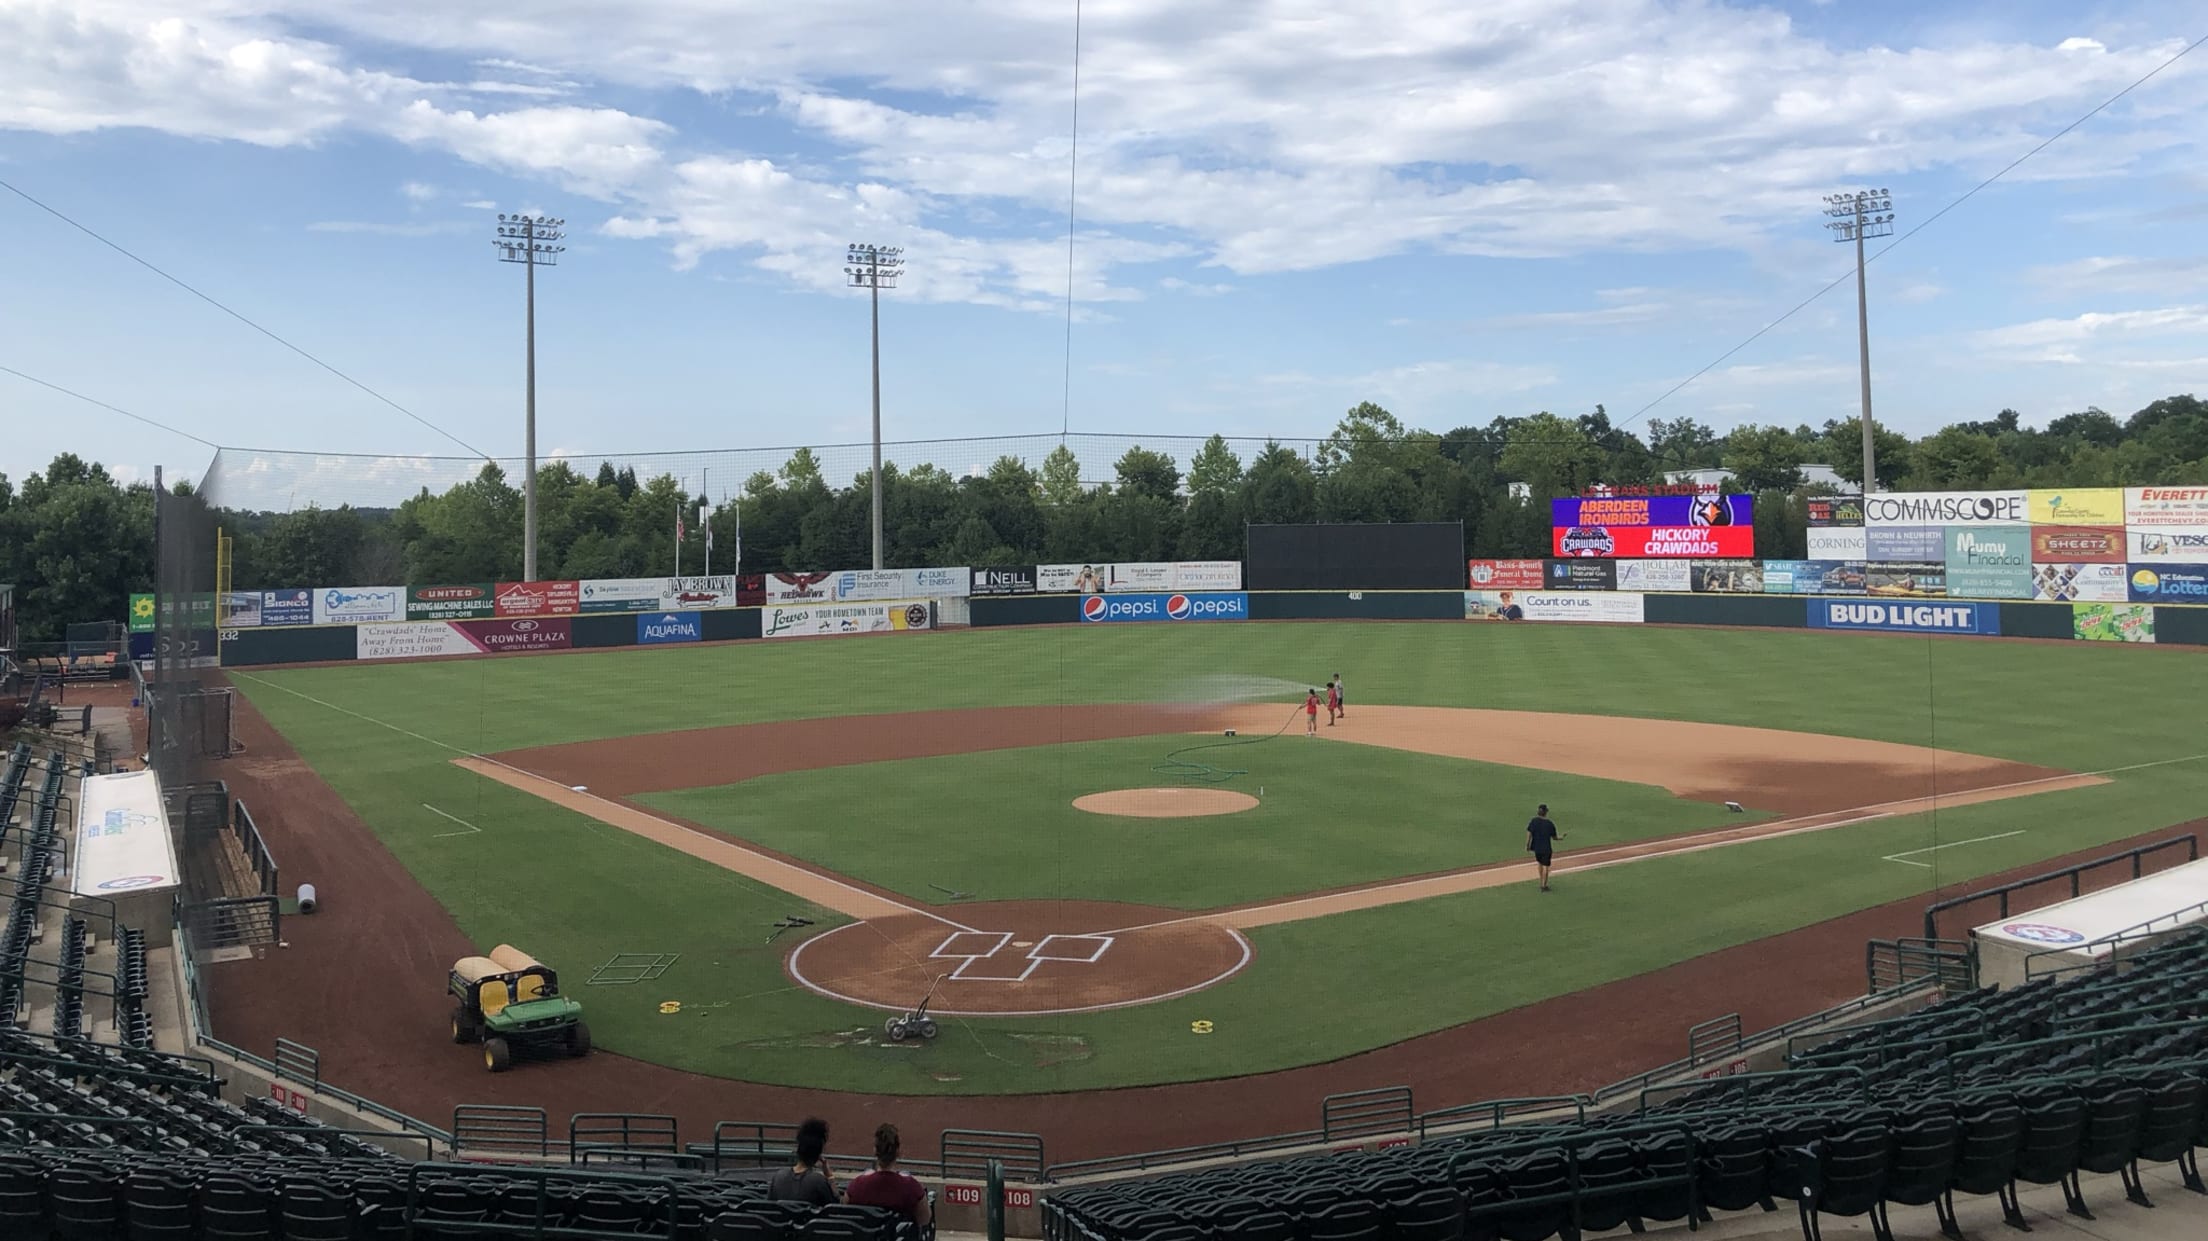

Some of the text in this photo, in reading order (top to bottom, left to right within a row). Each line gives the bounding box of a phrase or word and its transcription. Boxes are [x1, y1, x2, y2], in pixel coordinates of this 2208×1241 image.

[1579, 500, 1649, 512] ABERDEEN
[1866, 496, 2022, 521] COMMSCOPE
[1579, 512, 1649, 525] IRONBIRDS
[1652, 528, 1710, 541] HICKORY
[1562, 538, 1613, 552] CRAWDADS
[1644, 541, 1719, 554] CRAWDADS
[1808, 537, 1865, 549] CORNING
[1956, 532, 2006, 556] Mumy
[2048, 540, 2107, 549] SHEETZ
[1968, 545, 2024, 566] Financial
[857, 571, 901, 581] First Security
[928, 570, 946, 578] DUKE
[990, 571, 1030, 584] NEILL
[663, 578, 689, 598] JAY
[690, 576, 732, 596] BROWN
[857, 580, 889, 588] Insurance
[929, 578, 956, 586] ENERGY
[428, 590, 472, 598] UNITED
[408, 602, 433, 611] SEWING
[433, 601, 462, 610] MACHINE
[463, 600, 481, 609] SALES
[481, 600, 494, 609] LLC
[1193, 598, 1241, 616] pepsi
[1526, 595, 1559, 606] Count
[1577, 599, 1592, 607] us.
[815, 607, 883, 618] YOUR HOMETOWN TEAM
[1110, 599, 1156, 617] pepsi
[766, 609, 809, 635] Lowes
[1830, 604, 1971, 627] BUD LIGHT
[419, 624, 447, 633] Home
[645, 623, 696, 639] AQUAFINA
[361, 638, 385, 646] Away
[389, 636, 415, 645] From
[484, 632, 565, 644] CROWNE PLAZA
[369, 645, 442, 656] (828) 323-1000
[957, 1189, 979, 1202] 109
[1008, 1191, 1030, 1205] 108
